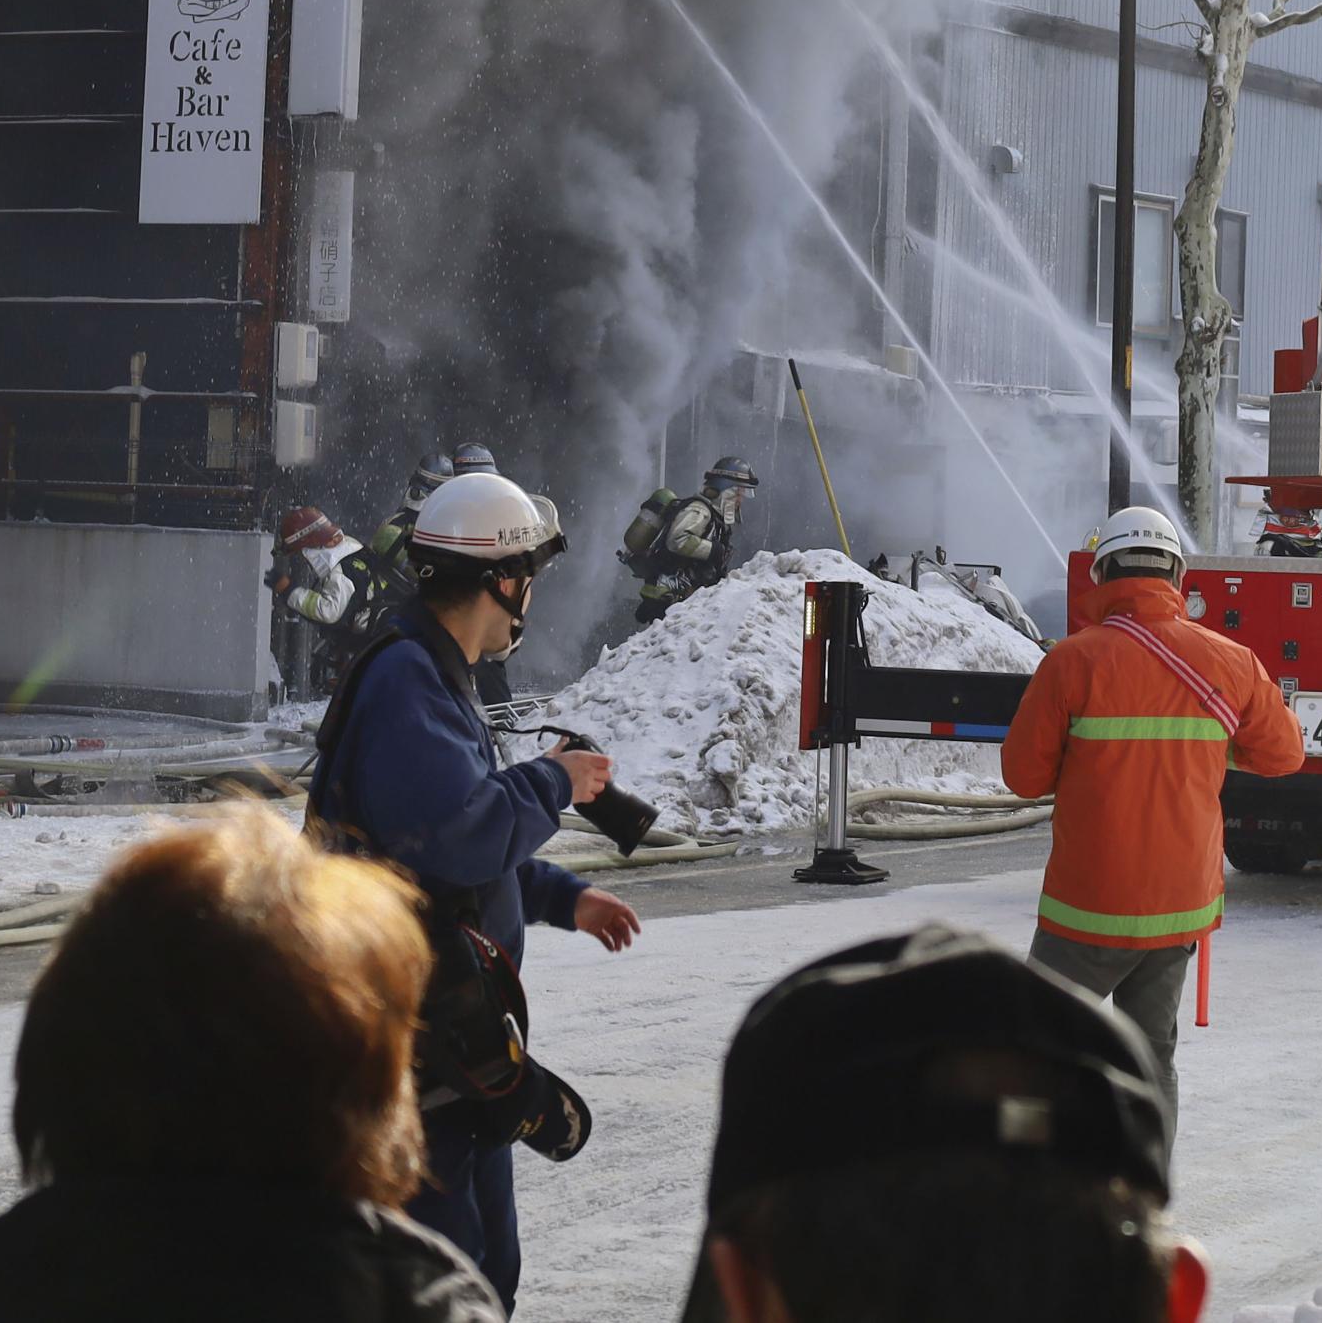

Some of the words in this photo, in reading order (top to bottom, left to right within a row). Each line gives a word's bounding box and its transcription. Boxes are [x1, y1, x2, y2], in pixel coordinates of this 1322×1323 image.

[169, 29, 242, 63] Cafe
[194, 65, 213, 86] &
[175, 86, 230, 118] Bar
[149, 122, 252, 153] Haven
[1130, 529, 1164, 540] 消防団
